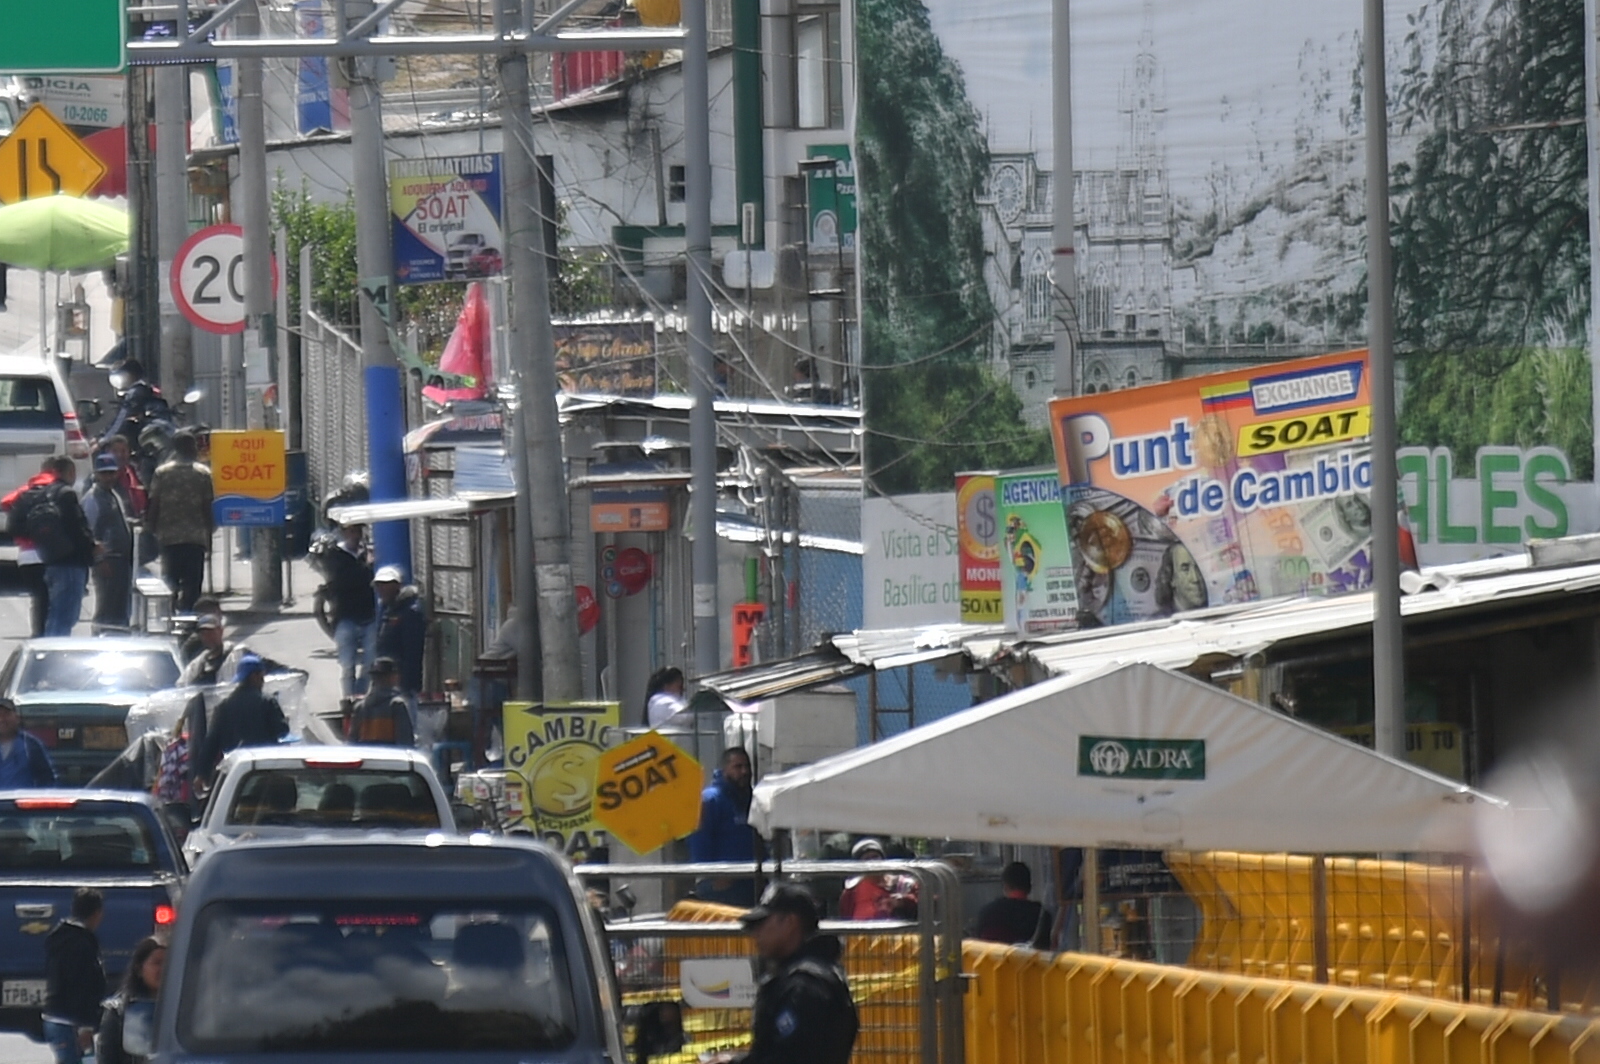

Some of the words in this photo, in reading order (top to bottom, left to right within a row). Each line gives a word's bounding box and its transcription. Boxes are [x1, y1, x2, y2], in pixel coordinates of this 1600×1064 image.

[63, 104, 108, 123] 10-2066
[415, 195, 469, 221] SOAT
[418, 222, 428, 234] El
[429, 219, 464, 237] original
[192, 253, 246, 305] 20
[1253, 372, 1352, 409] EXCHANGE
[1248, 410, 1360, 451] SOAT
[239, 452, 256, 464] SU
[220, 463, 276, 482] SOAT
[1002, 480, 1061, 506] AGENCIA
[1176, 479, 1224, 518] de
[1397, 454, 1569, 544] ALES
[881, 528, 922, 560] Visita
[927, 525, 939, 557] el
[883, 573, 937, 608] Basílica
[960, 597, 1002, 614] SOAT
[1431, 729, 1454, 751] TU
[1130, 748, 1193, 769] ADRA
[596, 753, 679, 812] SOAT
